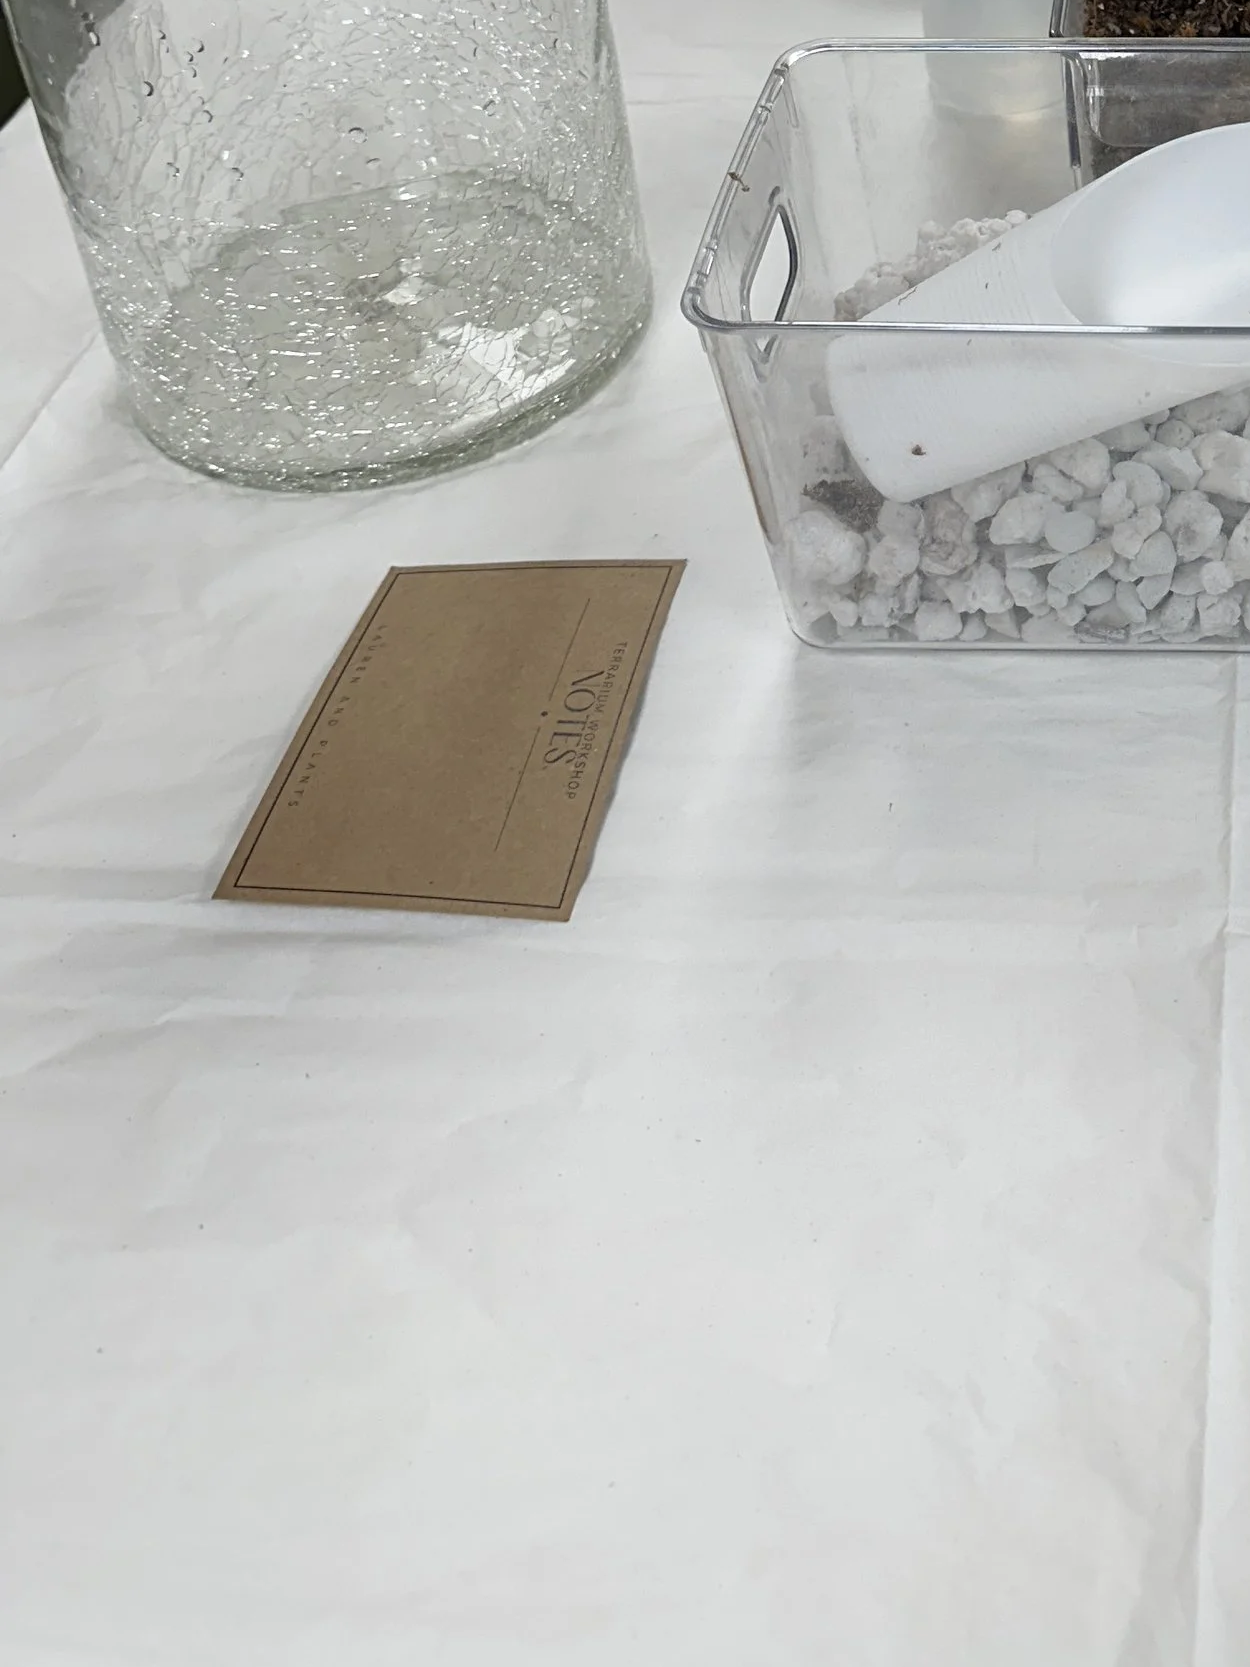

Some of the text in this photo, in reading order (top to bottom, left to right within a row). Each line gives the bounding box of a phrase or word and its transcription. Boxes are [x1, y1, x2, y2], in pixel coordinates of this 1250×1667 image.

[287, 624, 388, 808] LAUREN AND PLANTS
[543, 669, 605, 765] NOTES
[567, 641, 628, 800] TERRARIUM WORKSHOP
